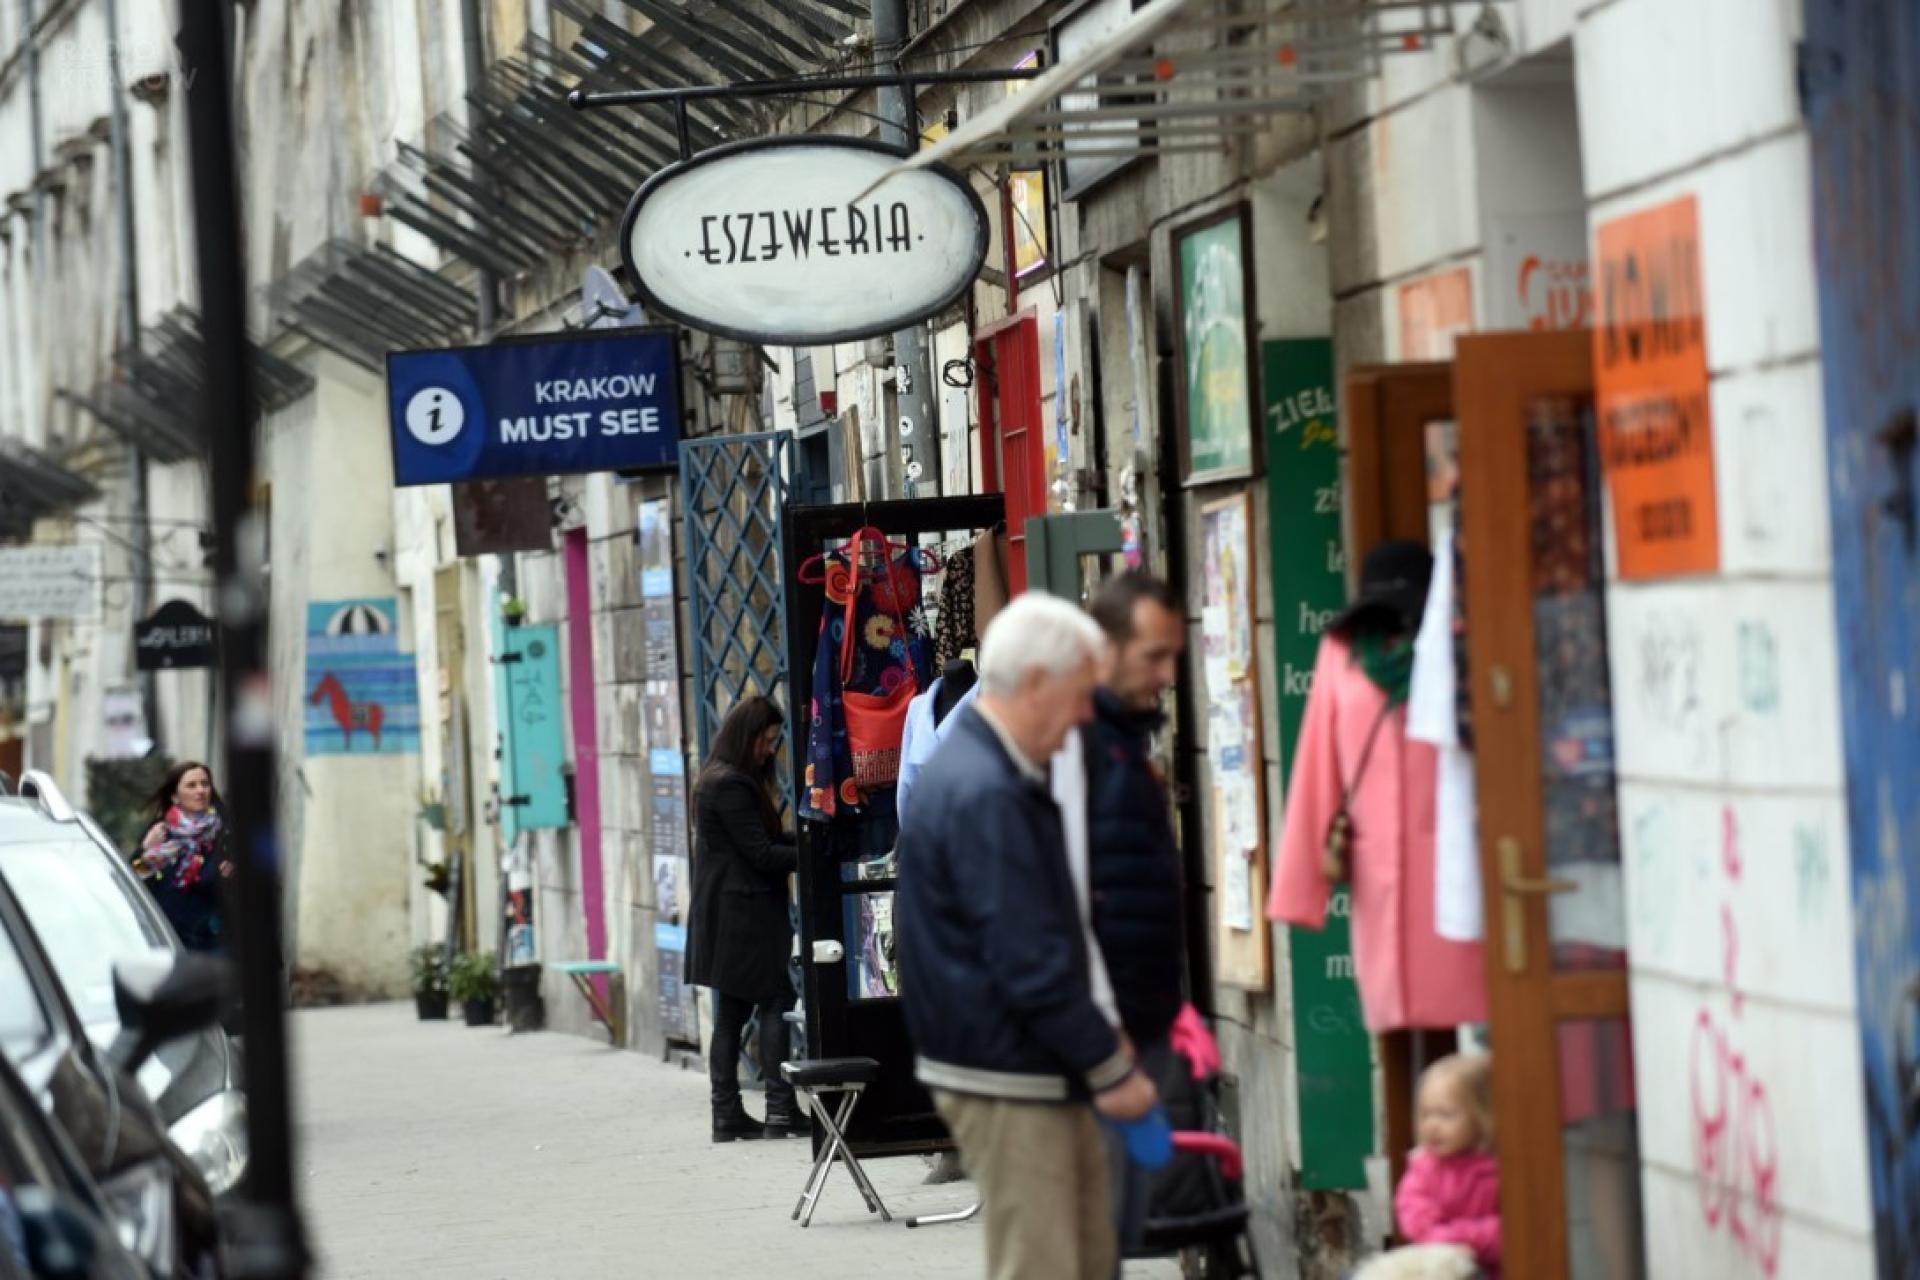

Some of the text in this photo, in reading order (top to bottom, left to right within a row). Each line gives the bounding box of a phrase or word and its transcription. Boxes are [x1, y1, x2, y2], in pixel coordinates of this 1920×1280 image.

[535, 373, 656, 404] KRAKOW
[500, 407, 660, 444] MUST SEE
